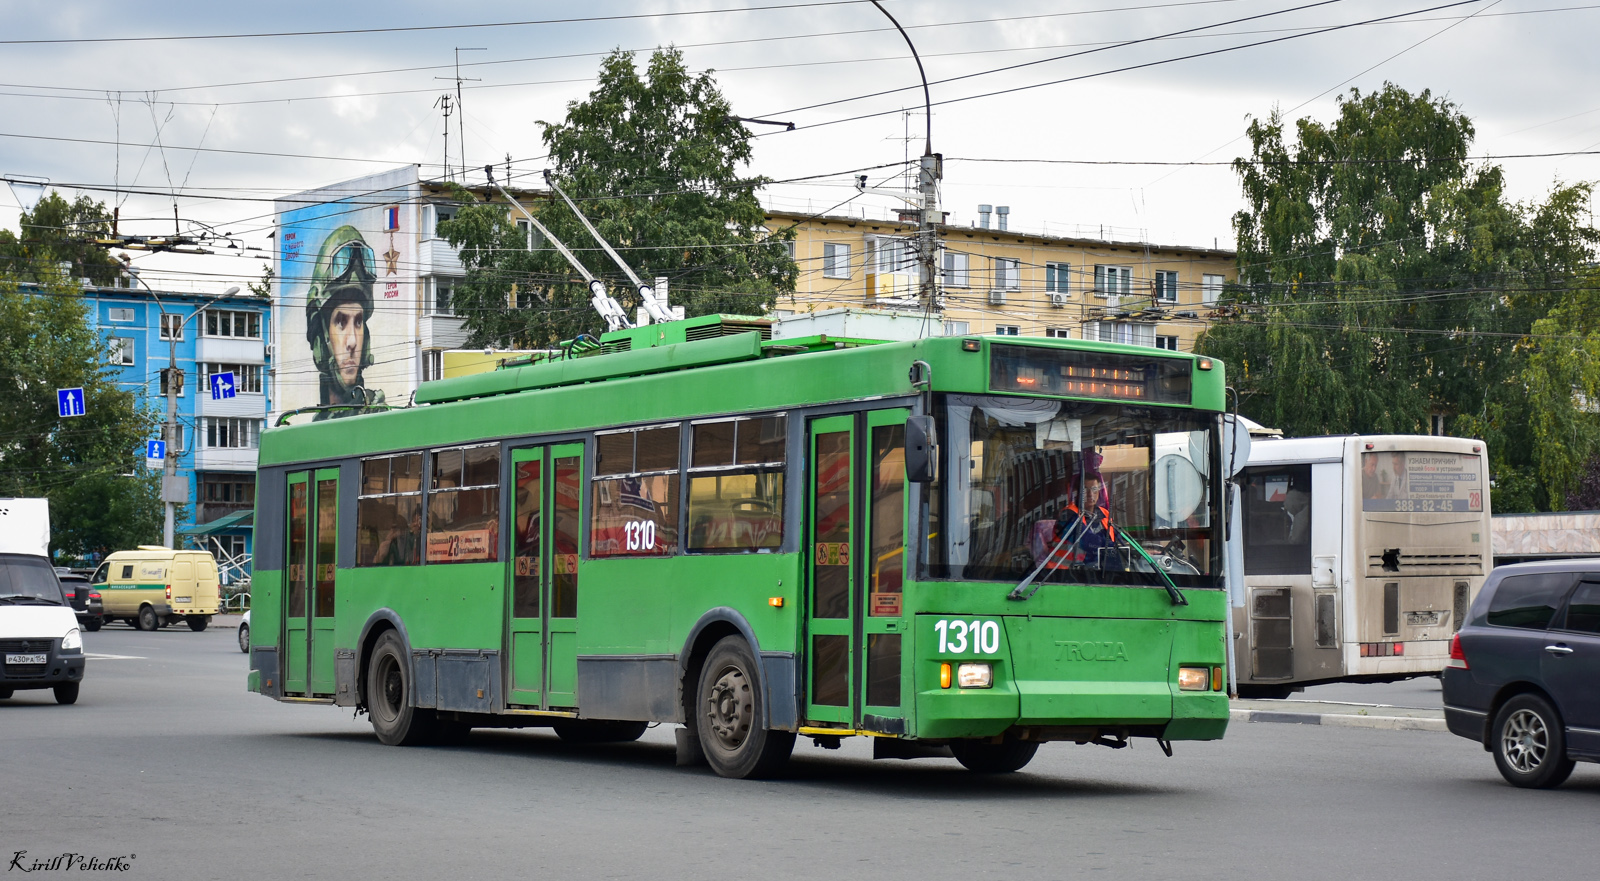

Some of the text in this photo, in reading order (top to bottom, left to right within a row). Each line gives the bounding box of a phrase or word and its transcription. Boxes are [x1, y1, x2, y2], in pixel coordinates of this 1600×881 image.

[386, 280, 397, 290] ГЕРОЙ
[384, 290, 398, 299] РОССИИ
[1408, 457, 1430, 465] УЗНАЕМ
[1431, 457, 1457, 465] ПРИЧИНУ
[1395, 500, 1414, 511] 388
[1469, 492, 1481, 508] 28
[624, 519, 655, 550] 1310
[448, 534, 460, 557] 23
[934, 619, 1000, 654] 1310
[1054, 640, 1129, 662] TROLZA
